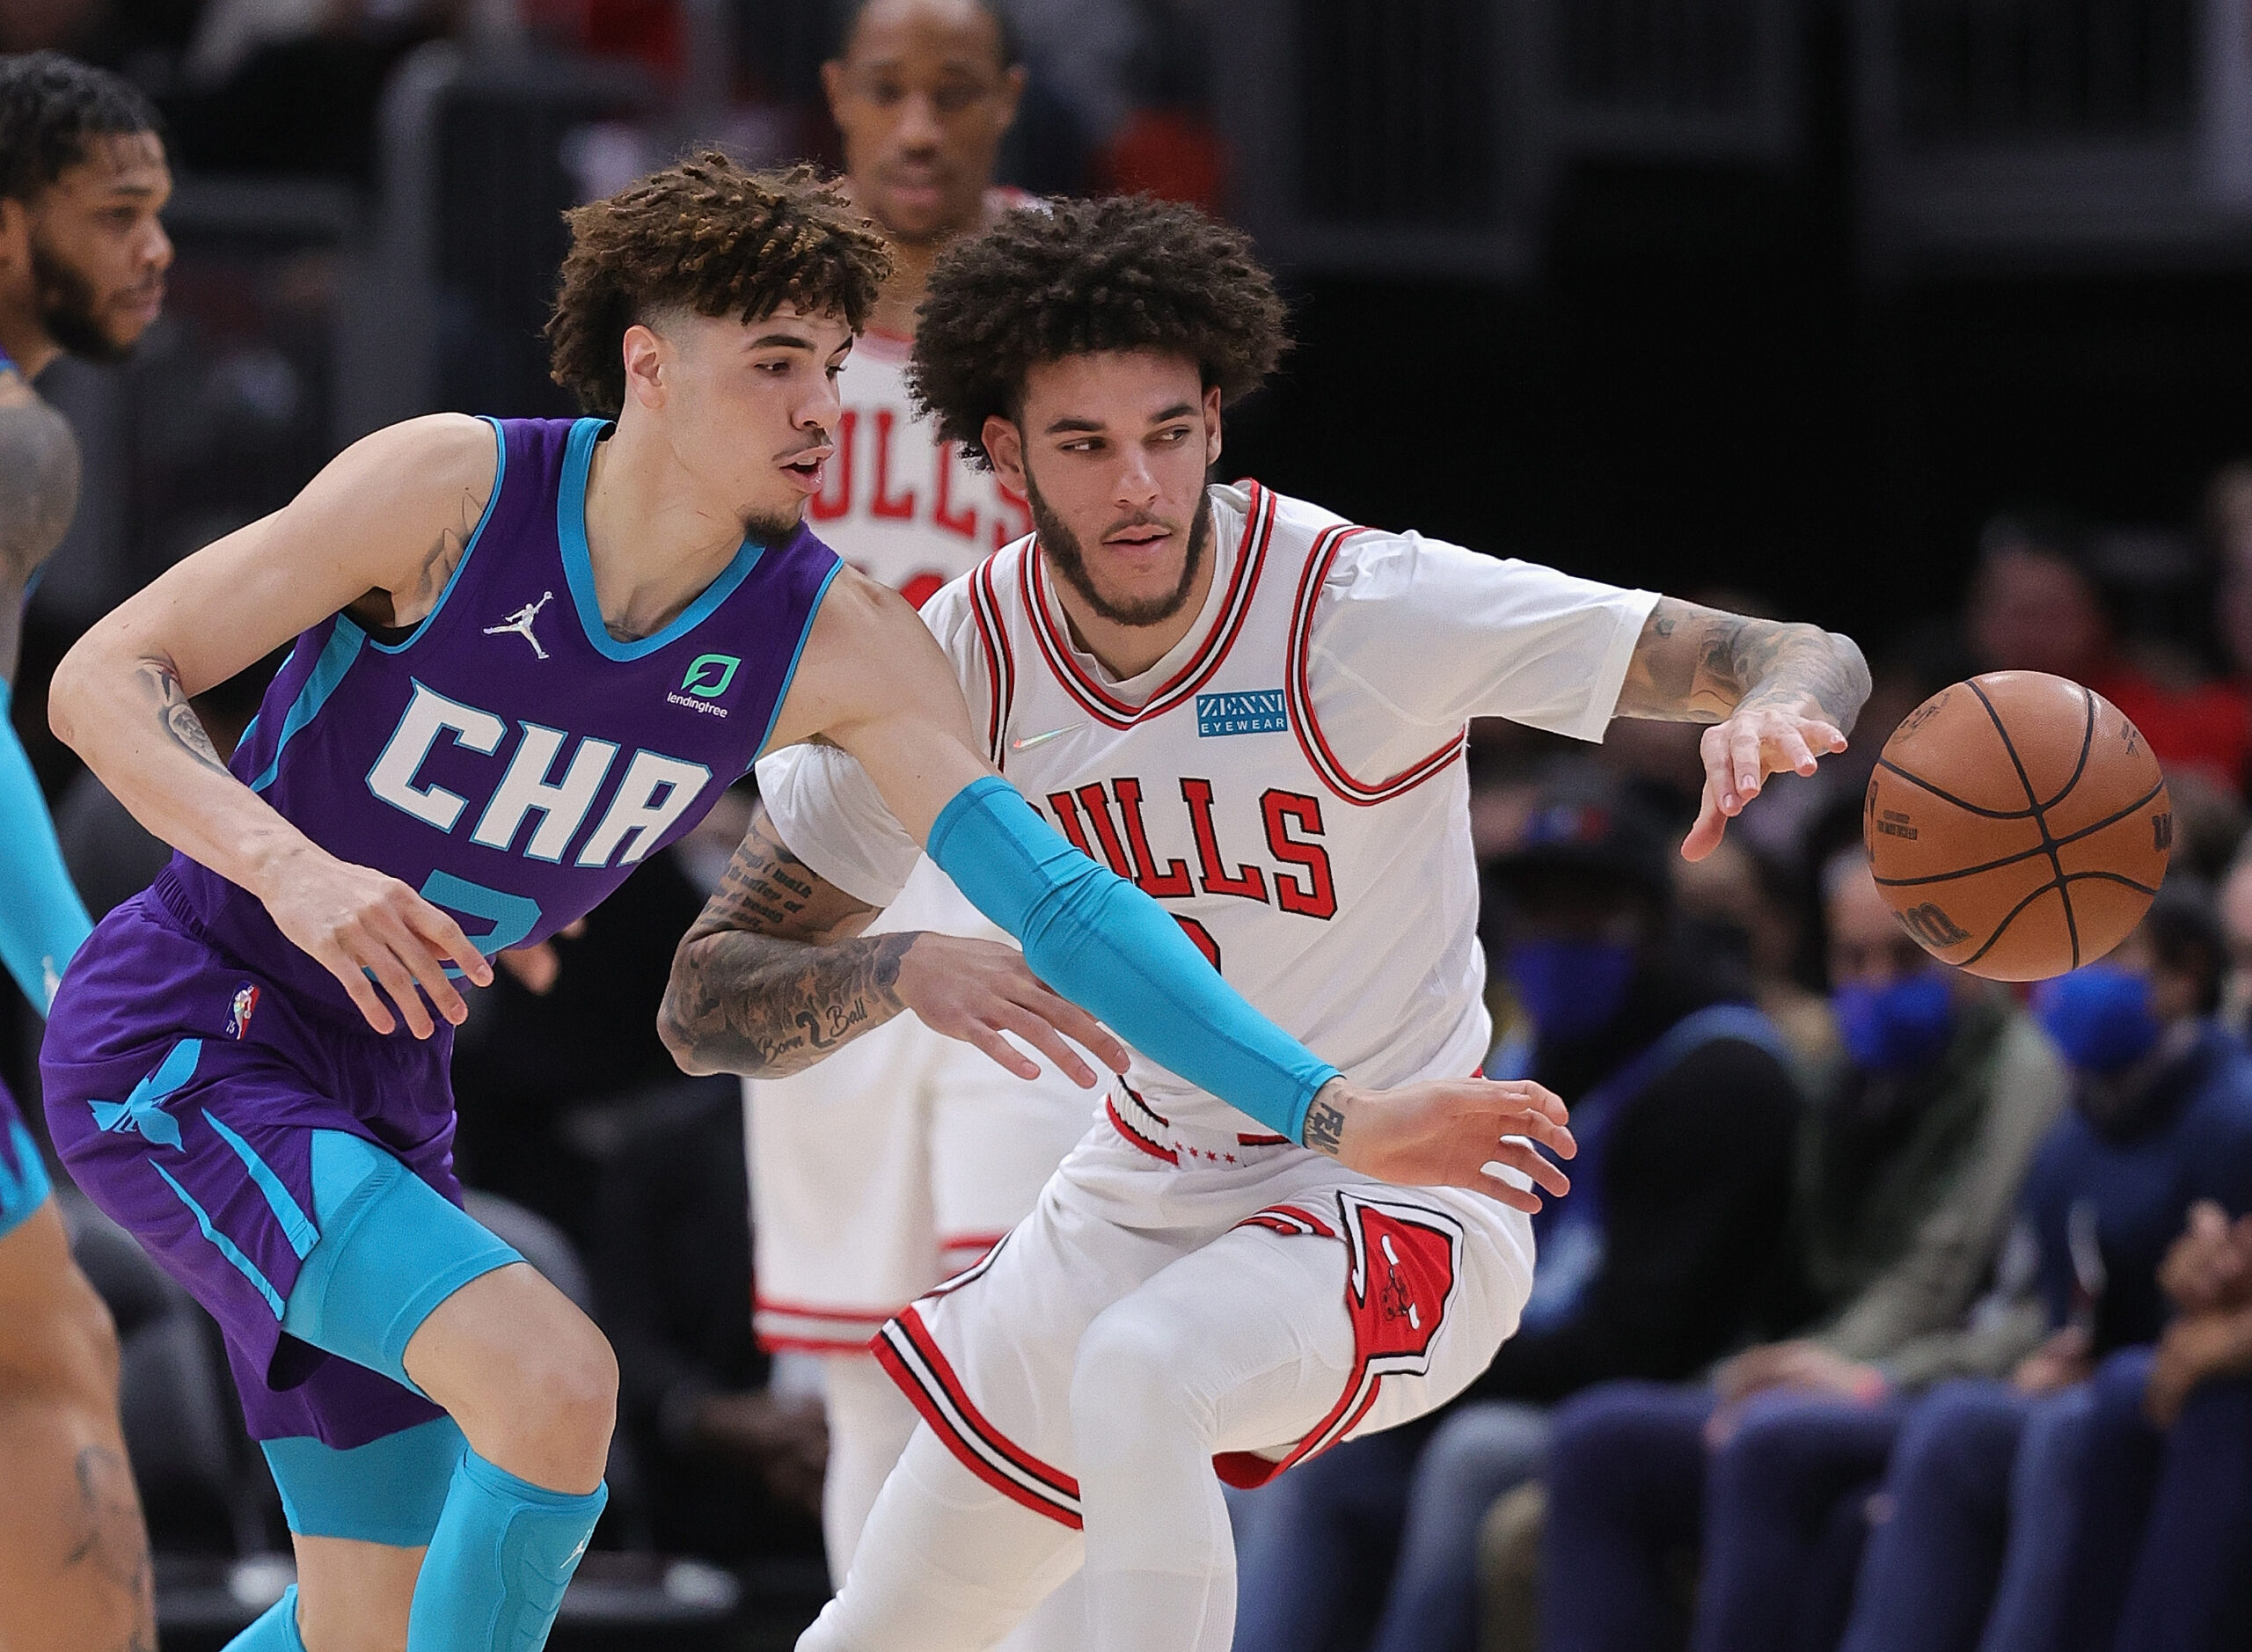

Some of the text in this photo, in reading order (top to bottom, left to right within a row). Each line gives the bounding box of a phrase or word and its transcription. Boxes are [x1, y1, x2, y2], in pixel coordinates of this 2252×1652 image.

[667, 691, 728, 718] lendingtree
[1199, 693, 1283, 718] ZENNI
[1201, 718, 1284, 734] EYEWEAR
[364, 676, 713, 867] CHA
[1026, 777, 1339, 922] ULLS
[795, 1010, 837, 1049] 2
[826, 997, 867, 1038] Ball
